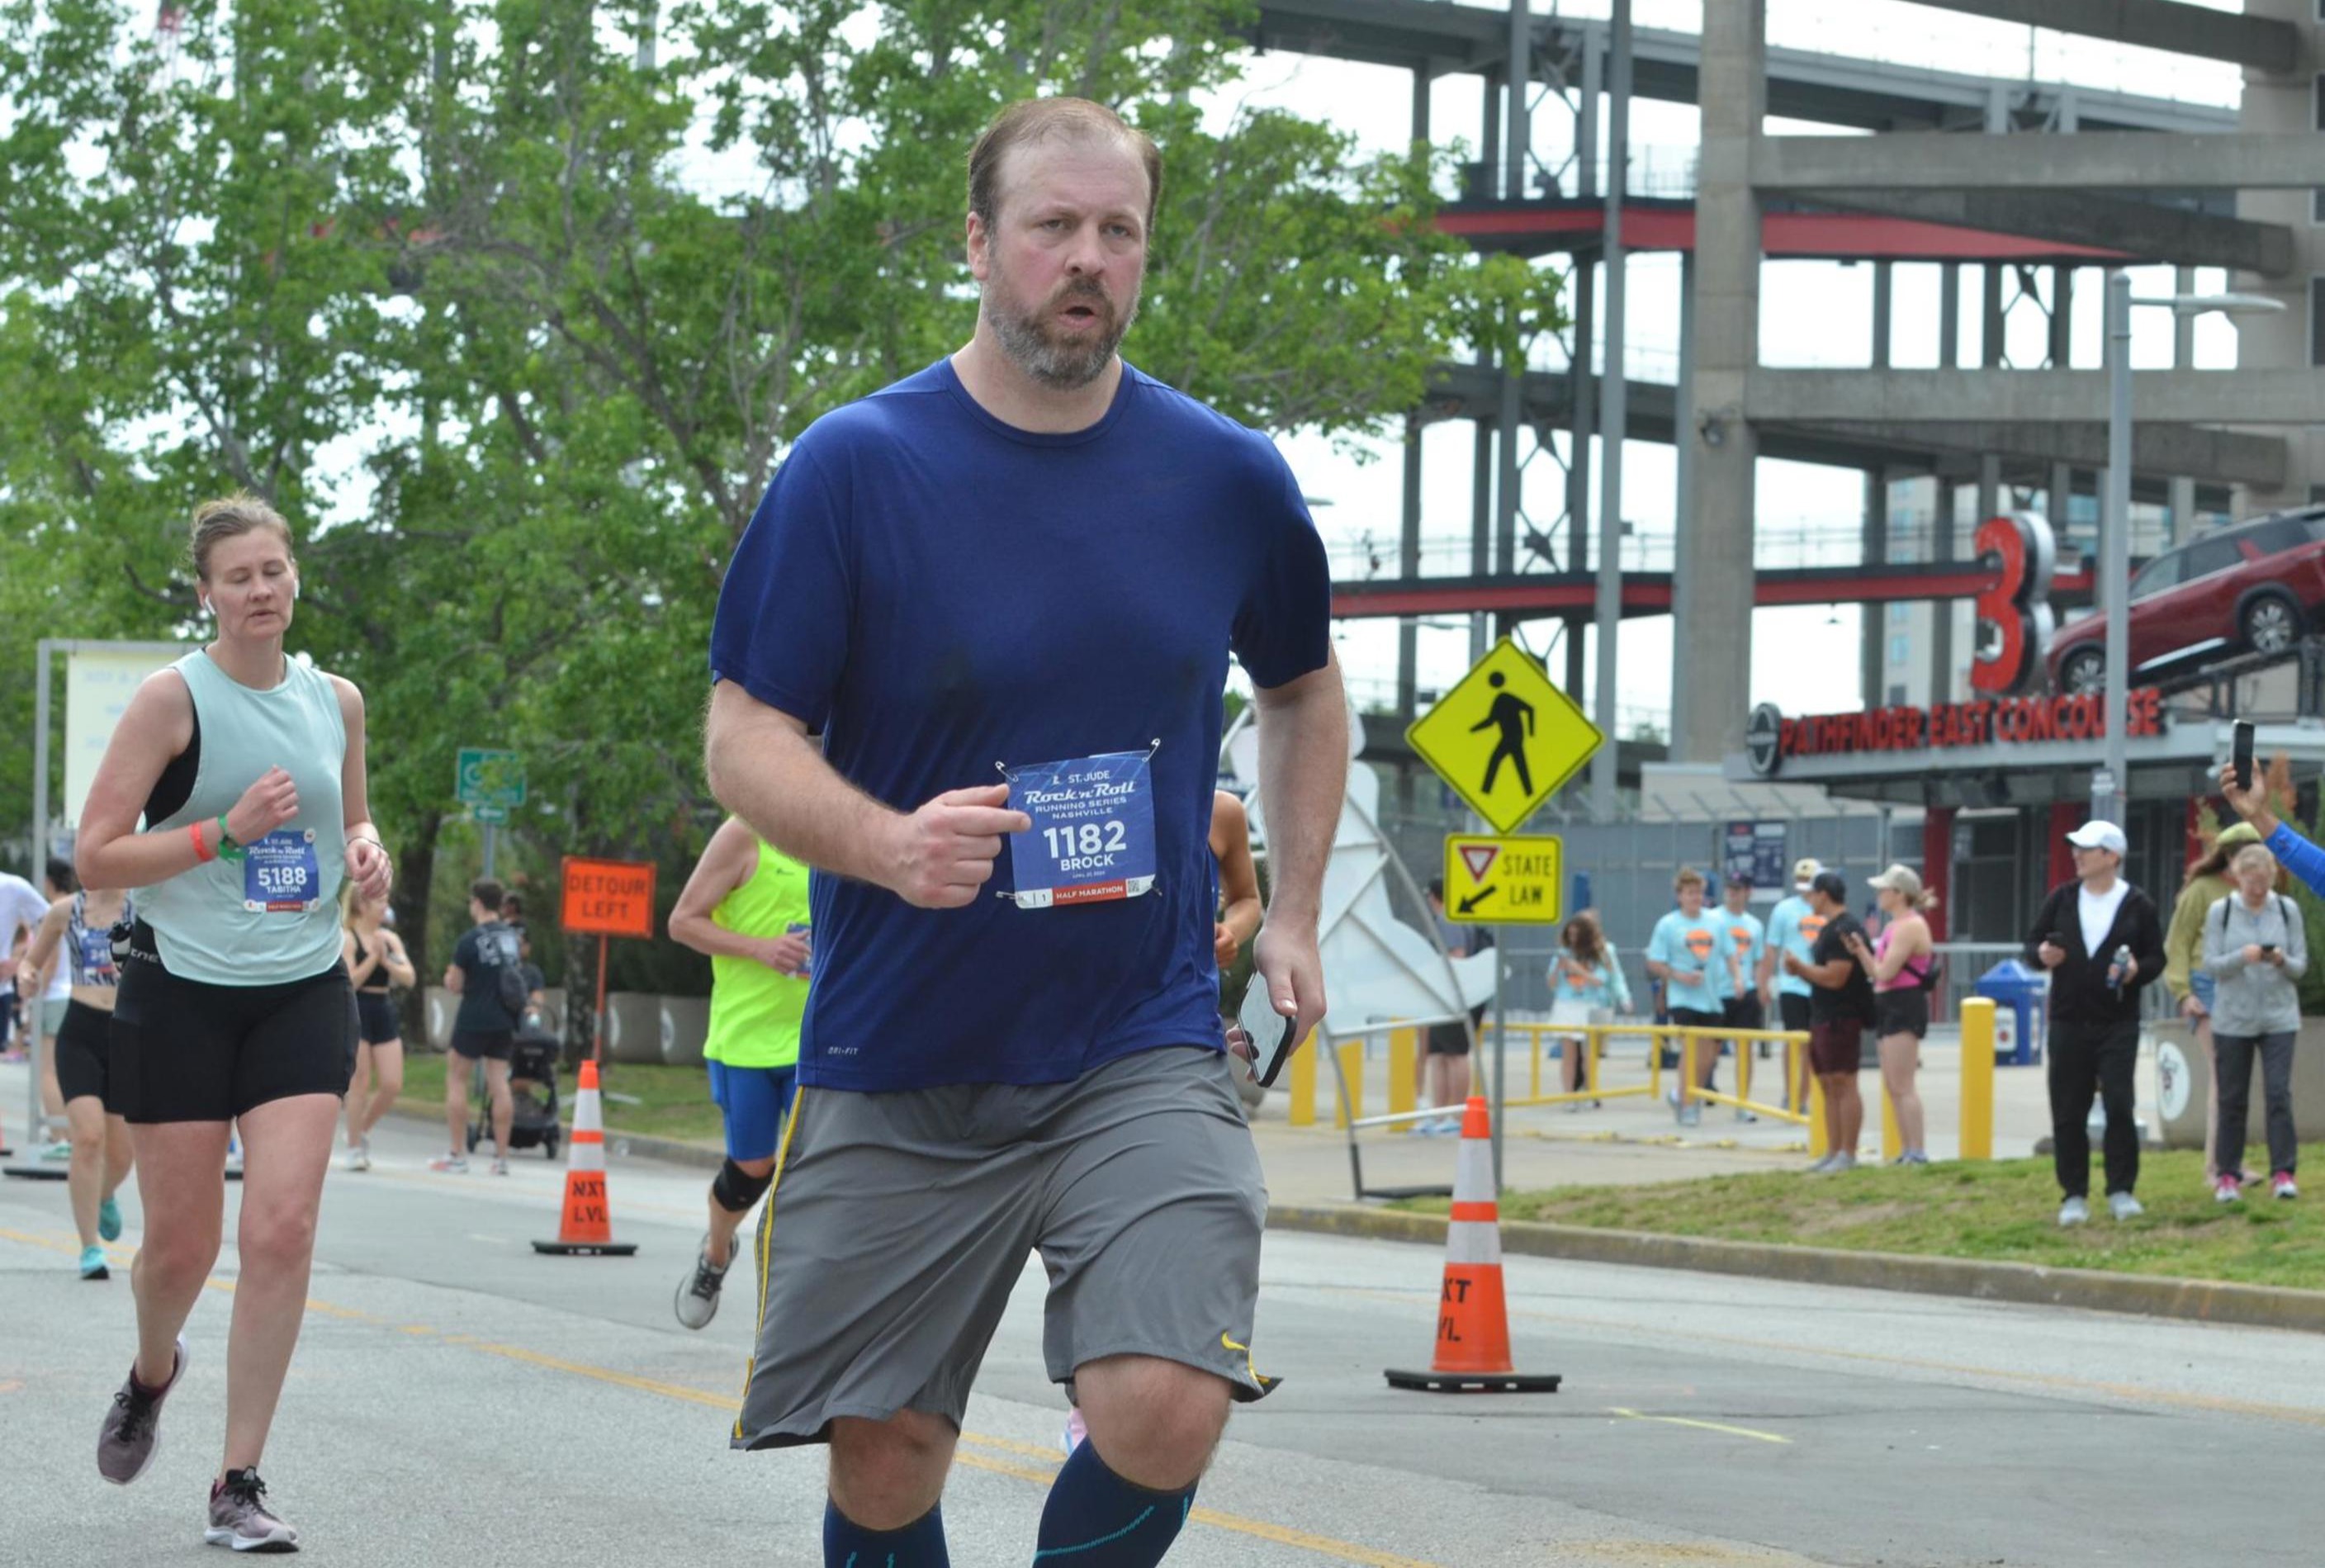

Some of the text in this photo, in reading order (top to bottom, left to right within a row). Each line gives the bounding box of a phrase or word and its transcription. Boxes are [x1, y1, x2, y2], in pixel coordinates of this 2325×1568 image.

[1970, 514, 2035, 693] 3
[1780, 686, 2161, 757] PATHFINDER EAST CONCOUSE
[1024, 789, 1077, 804] Rock
[1093, 781, 1136, 797] Roll
[1035, 796, 1127, 813] RUNNING SERIES
[1052, 807, 1114, 820] NASHVILLE
[1043, 820, 1127, 859] 1182
[1060, 853, 1115, 872] BROCK
[1503, 855, 1551, 877] STATE
[258, 866, 307, 887] 5188
[568, 874, 646, 896] DETOUR
[266, 885, 301, 894] TABITHA
[1056, 888, 1077, 900] HALF
[1078, 884, 1124, 898] MARATHON
[1509, 885, 1543, 906] LAW
[582, 900, 629, 921] LEFT
[574, 1206, 607, 1223] LVL
